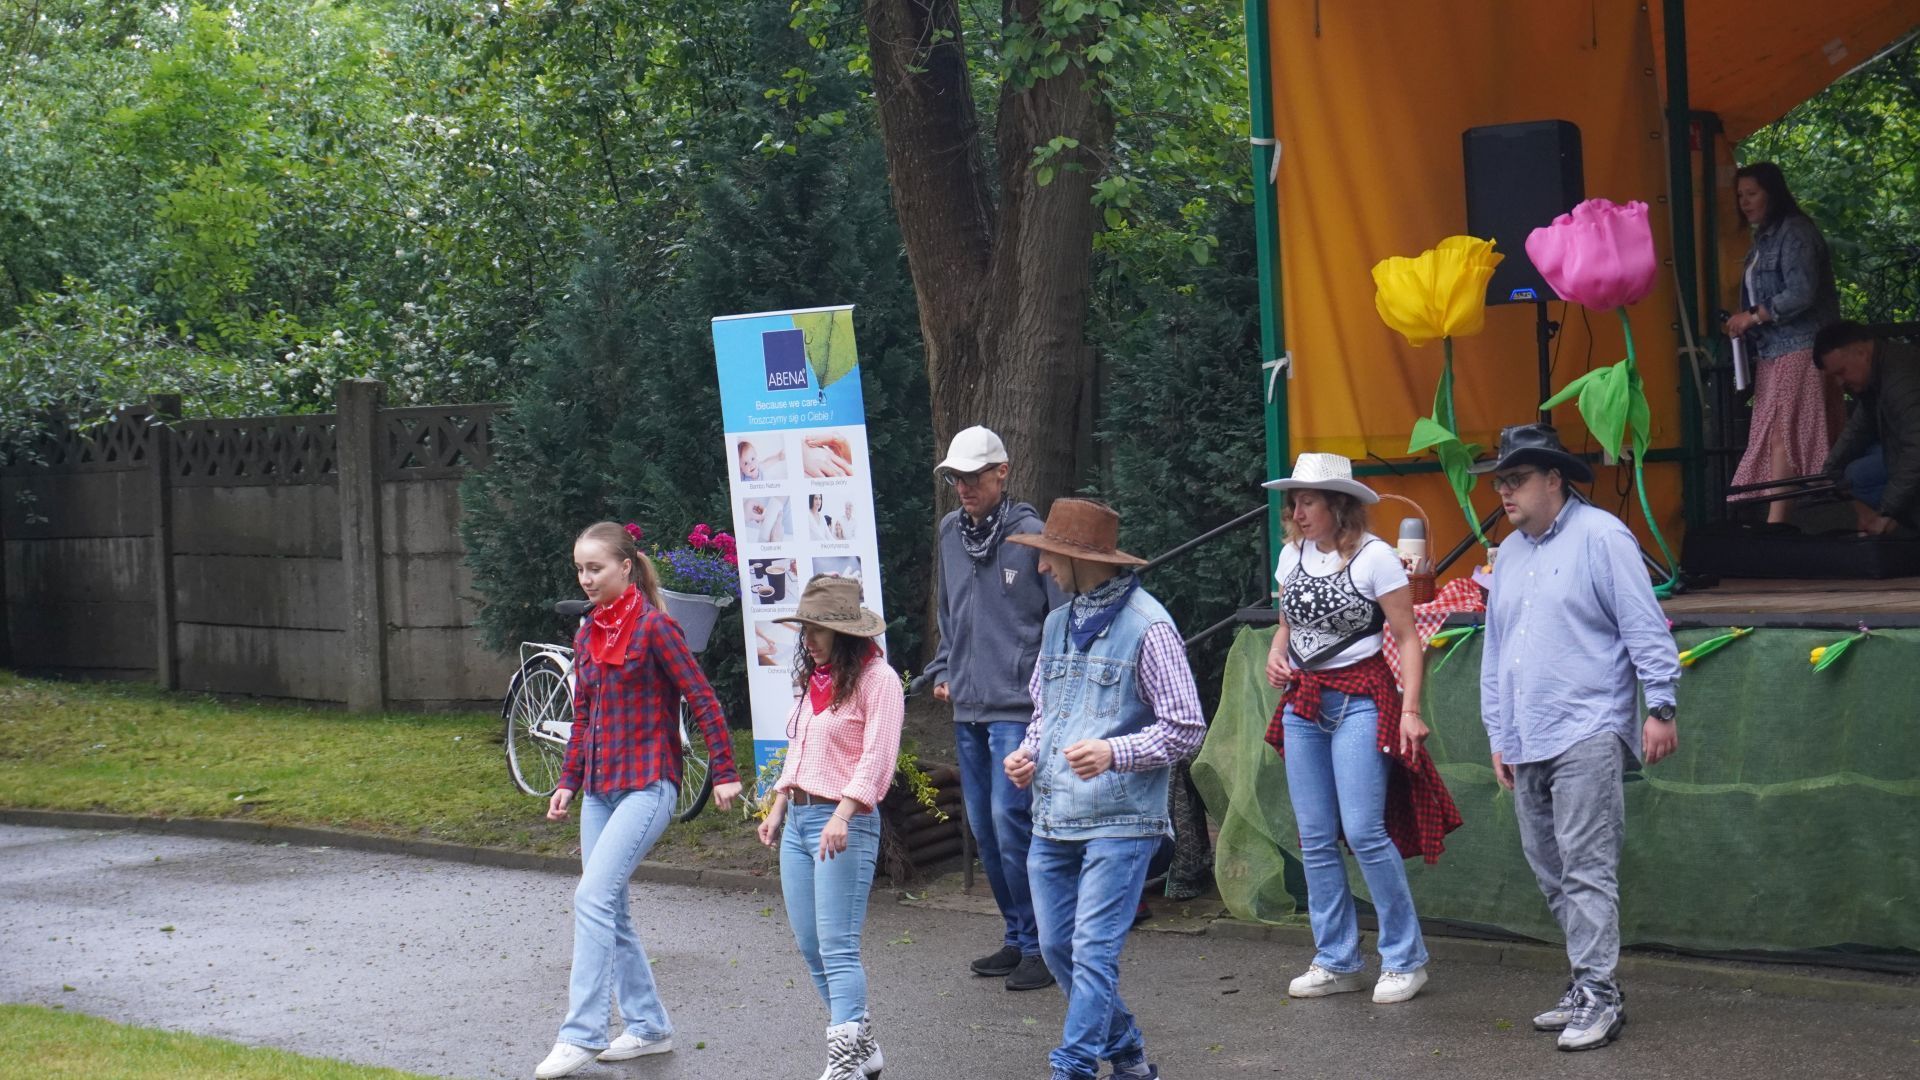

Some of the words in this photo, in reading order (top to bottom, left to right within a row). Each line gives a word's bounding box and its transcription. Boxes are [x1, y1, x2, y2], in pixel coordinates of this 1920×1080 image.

[755, 401, 788, 410] Because
[747, 415, 787, 425] Troszczymy
[800, 414, 806, 422] o
[807, 410, 829, 421] Ciebie
[1005, 571, 1016, 584] W
